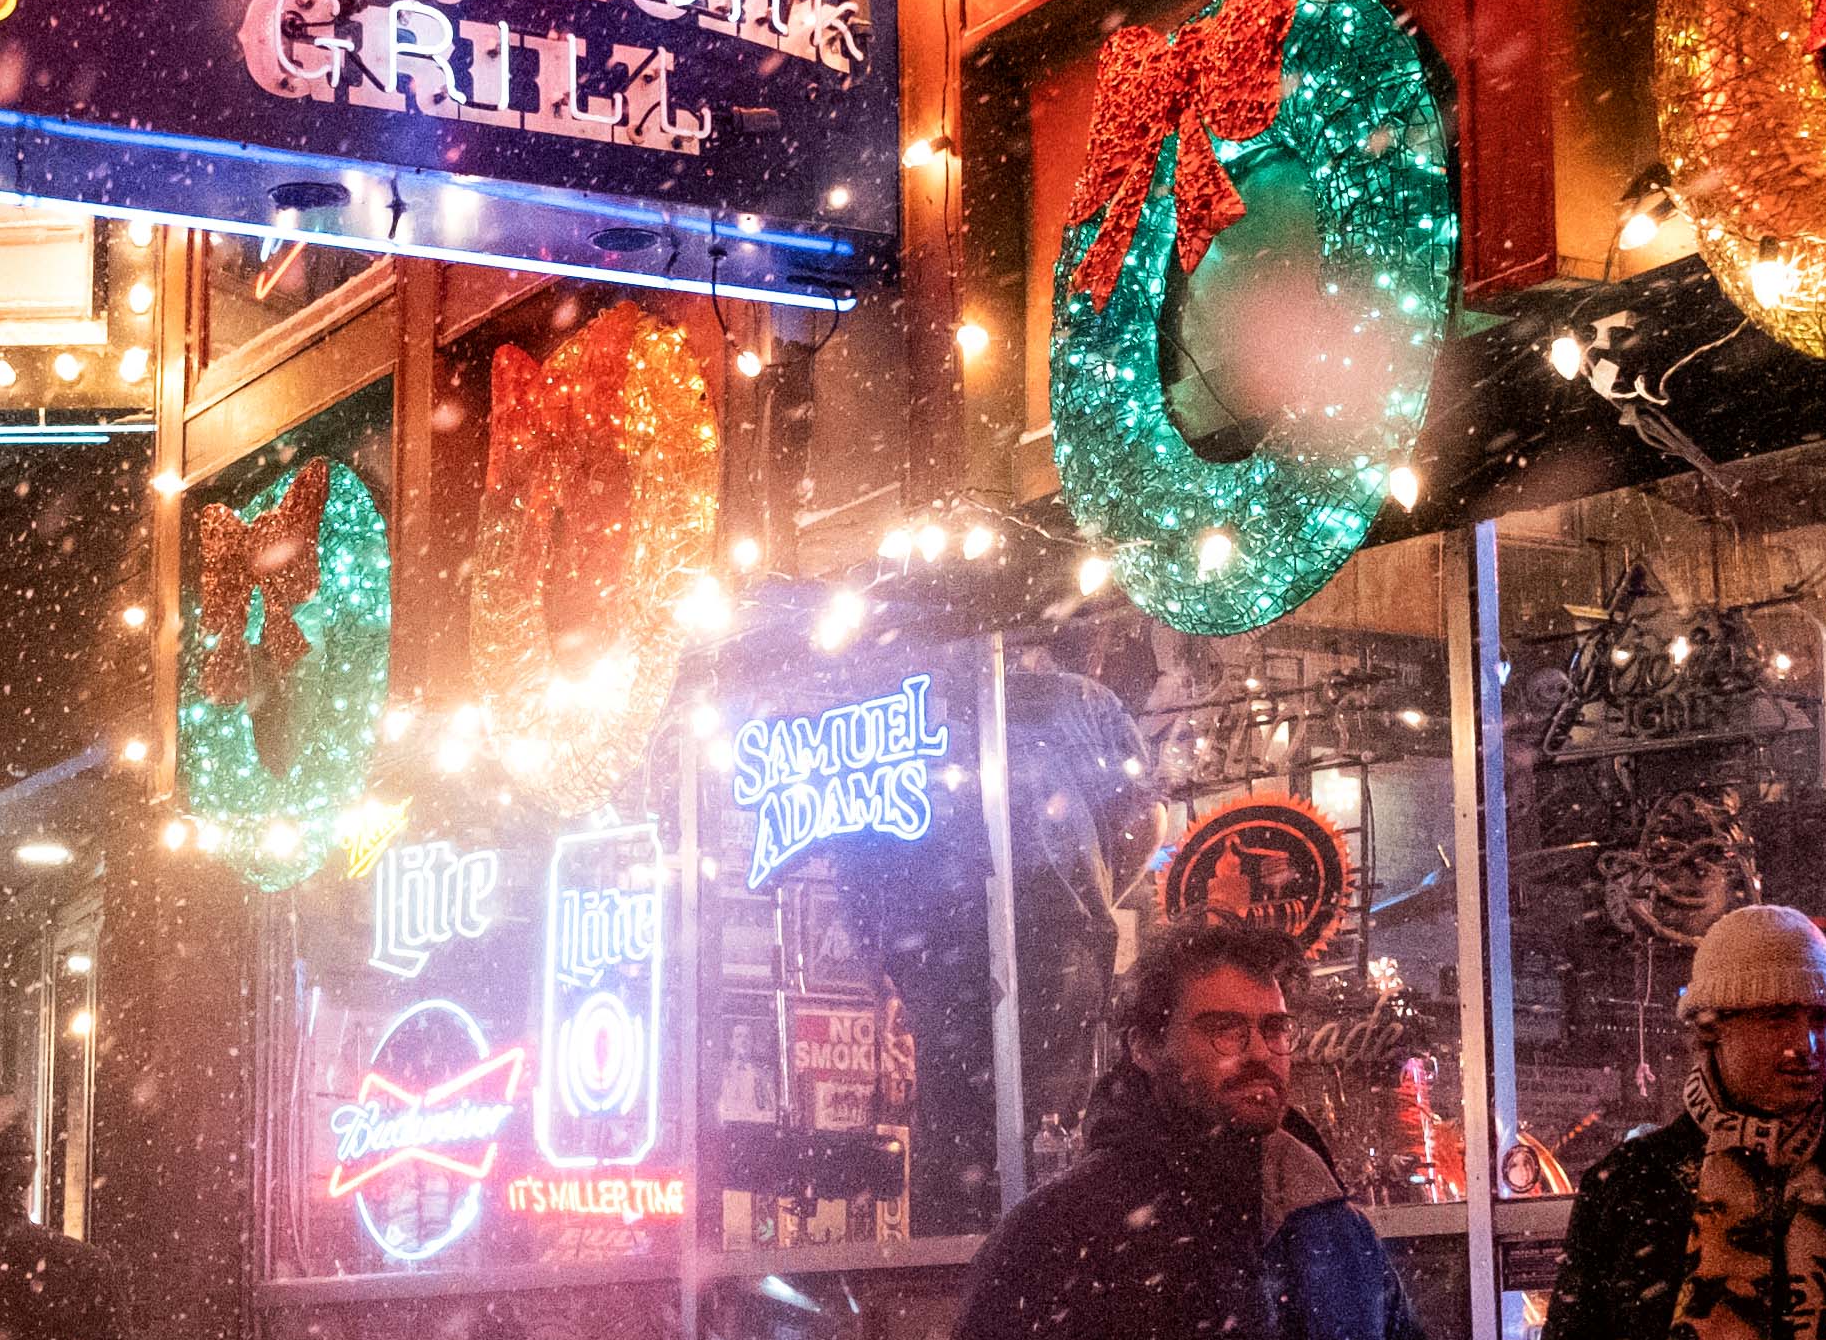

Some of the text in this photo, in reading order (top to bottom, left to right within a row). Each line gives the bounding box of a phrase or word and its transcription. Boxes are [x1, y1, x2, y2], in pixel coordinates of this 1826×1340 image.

[733, 672, 950, 806] SAMUEL
[746, 759, 935, 891] ADAMS
[367, 839, 501, 979] Lite
[827, 1015, 875, 1045] NO
